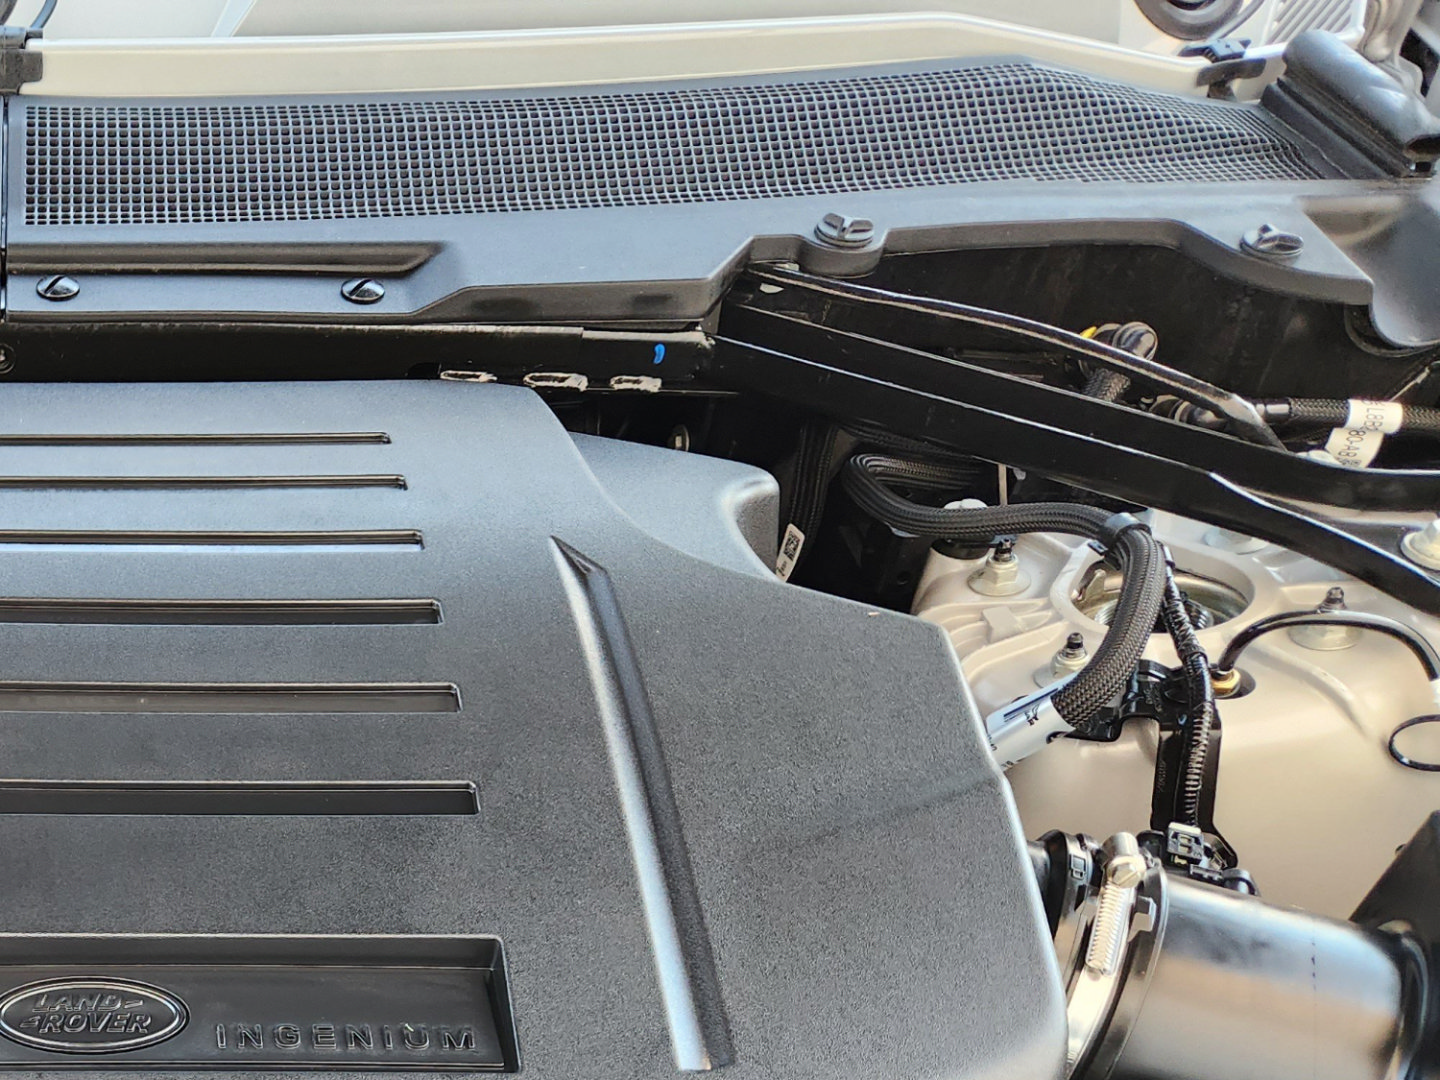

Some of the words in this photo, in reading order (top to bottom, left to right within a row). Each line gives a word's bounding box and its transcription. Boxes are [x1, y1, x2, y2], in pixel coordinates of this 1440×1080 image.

[33, 993, 122, 1012] LAND
[39, 1011, 152, 1034] ROVER
[215, 1022, 477, 1051] INGENIUM
